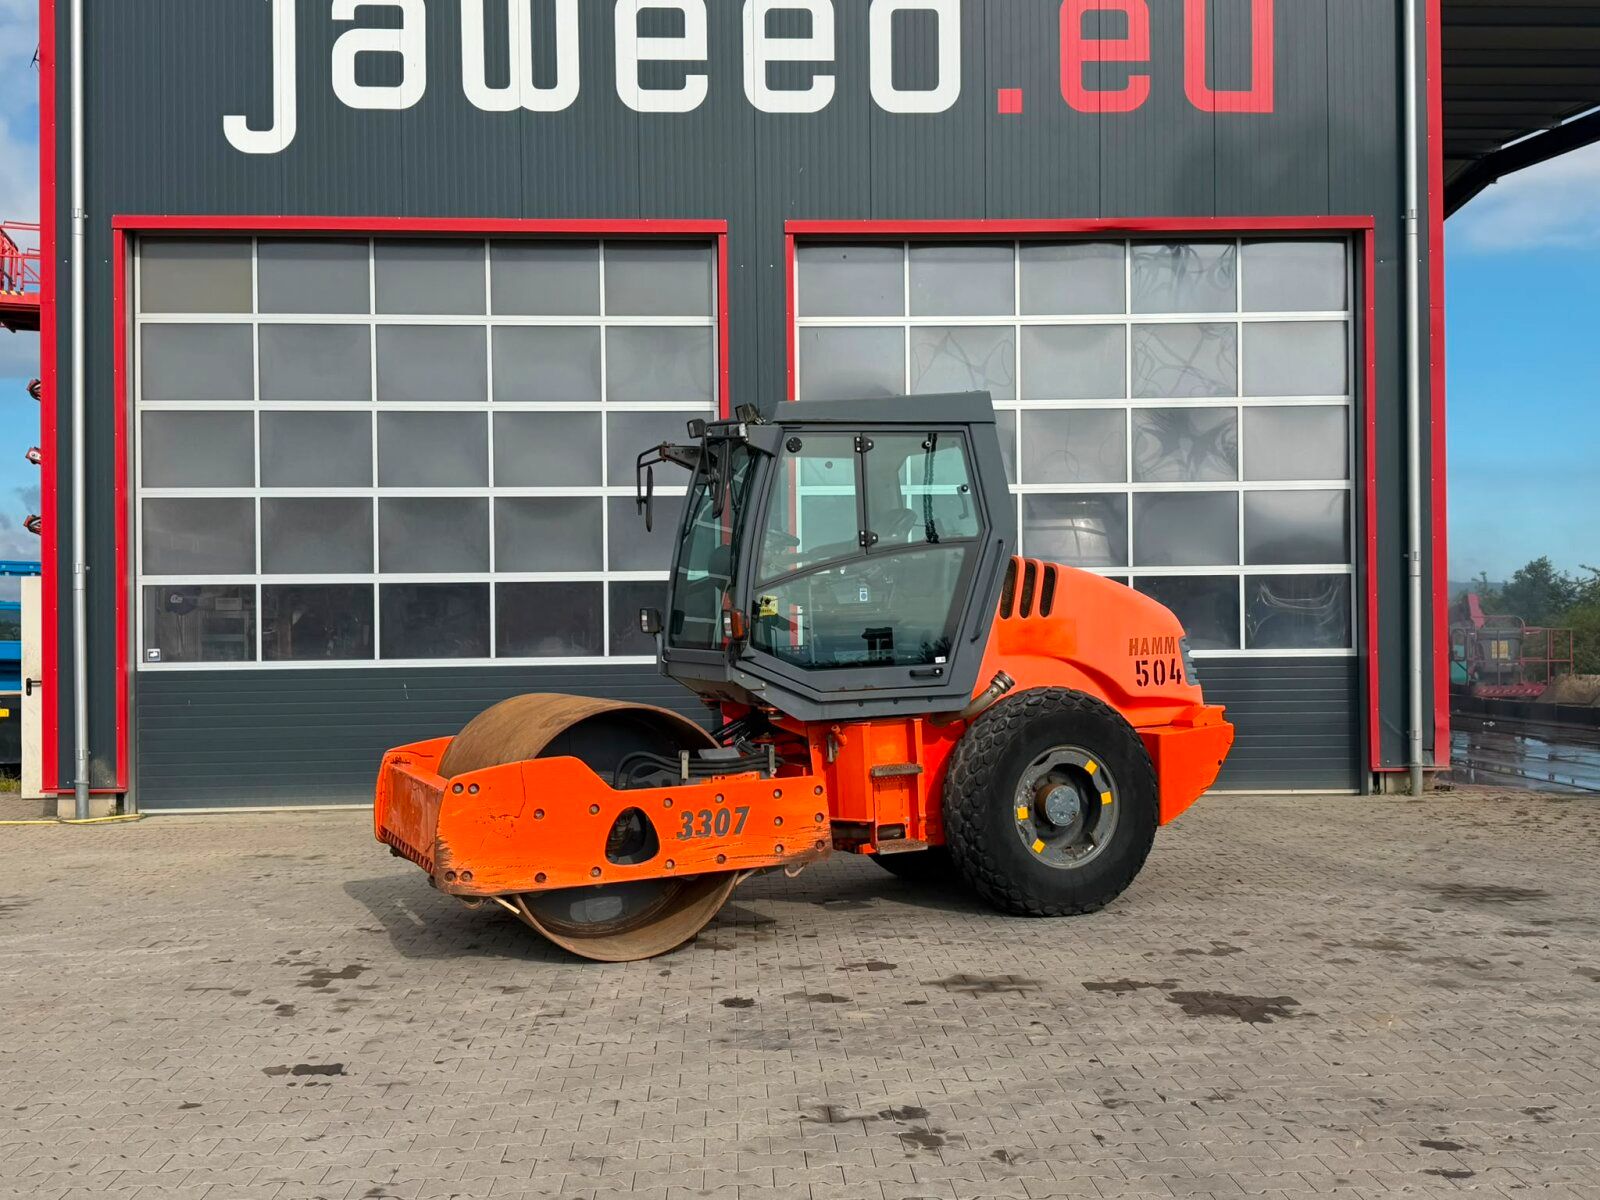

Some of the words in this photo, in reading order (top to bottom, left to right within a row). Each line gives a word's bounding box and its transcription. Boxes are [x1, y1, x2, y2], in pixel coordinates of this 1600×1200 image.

[1128, 636, 1175, 656] HAMM
[1135, 658, 1182, 687] 504
[676, 805, 750, 841] 3307
